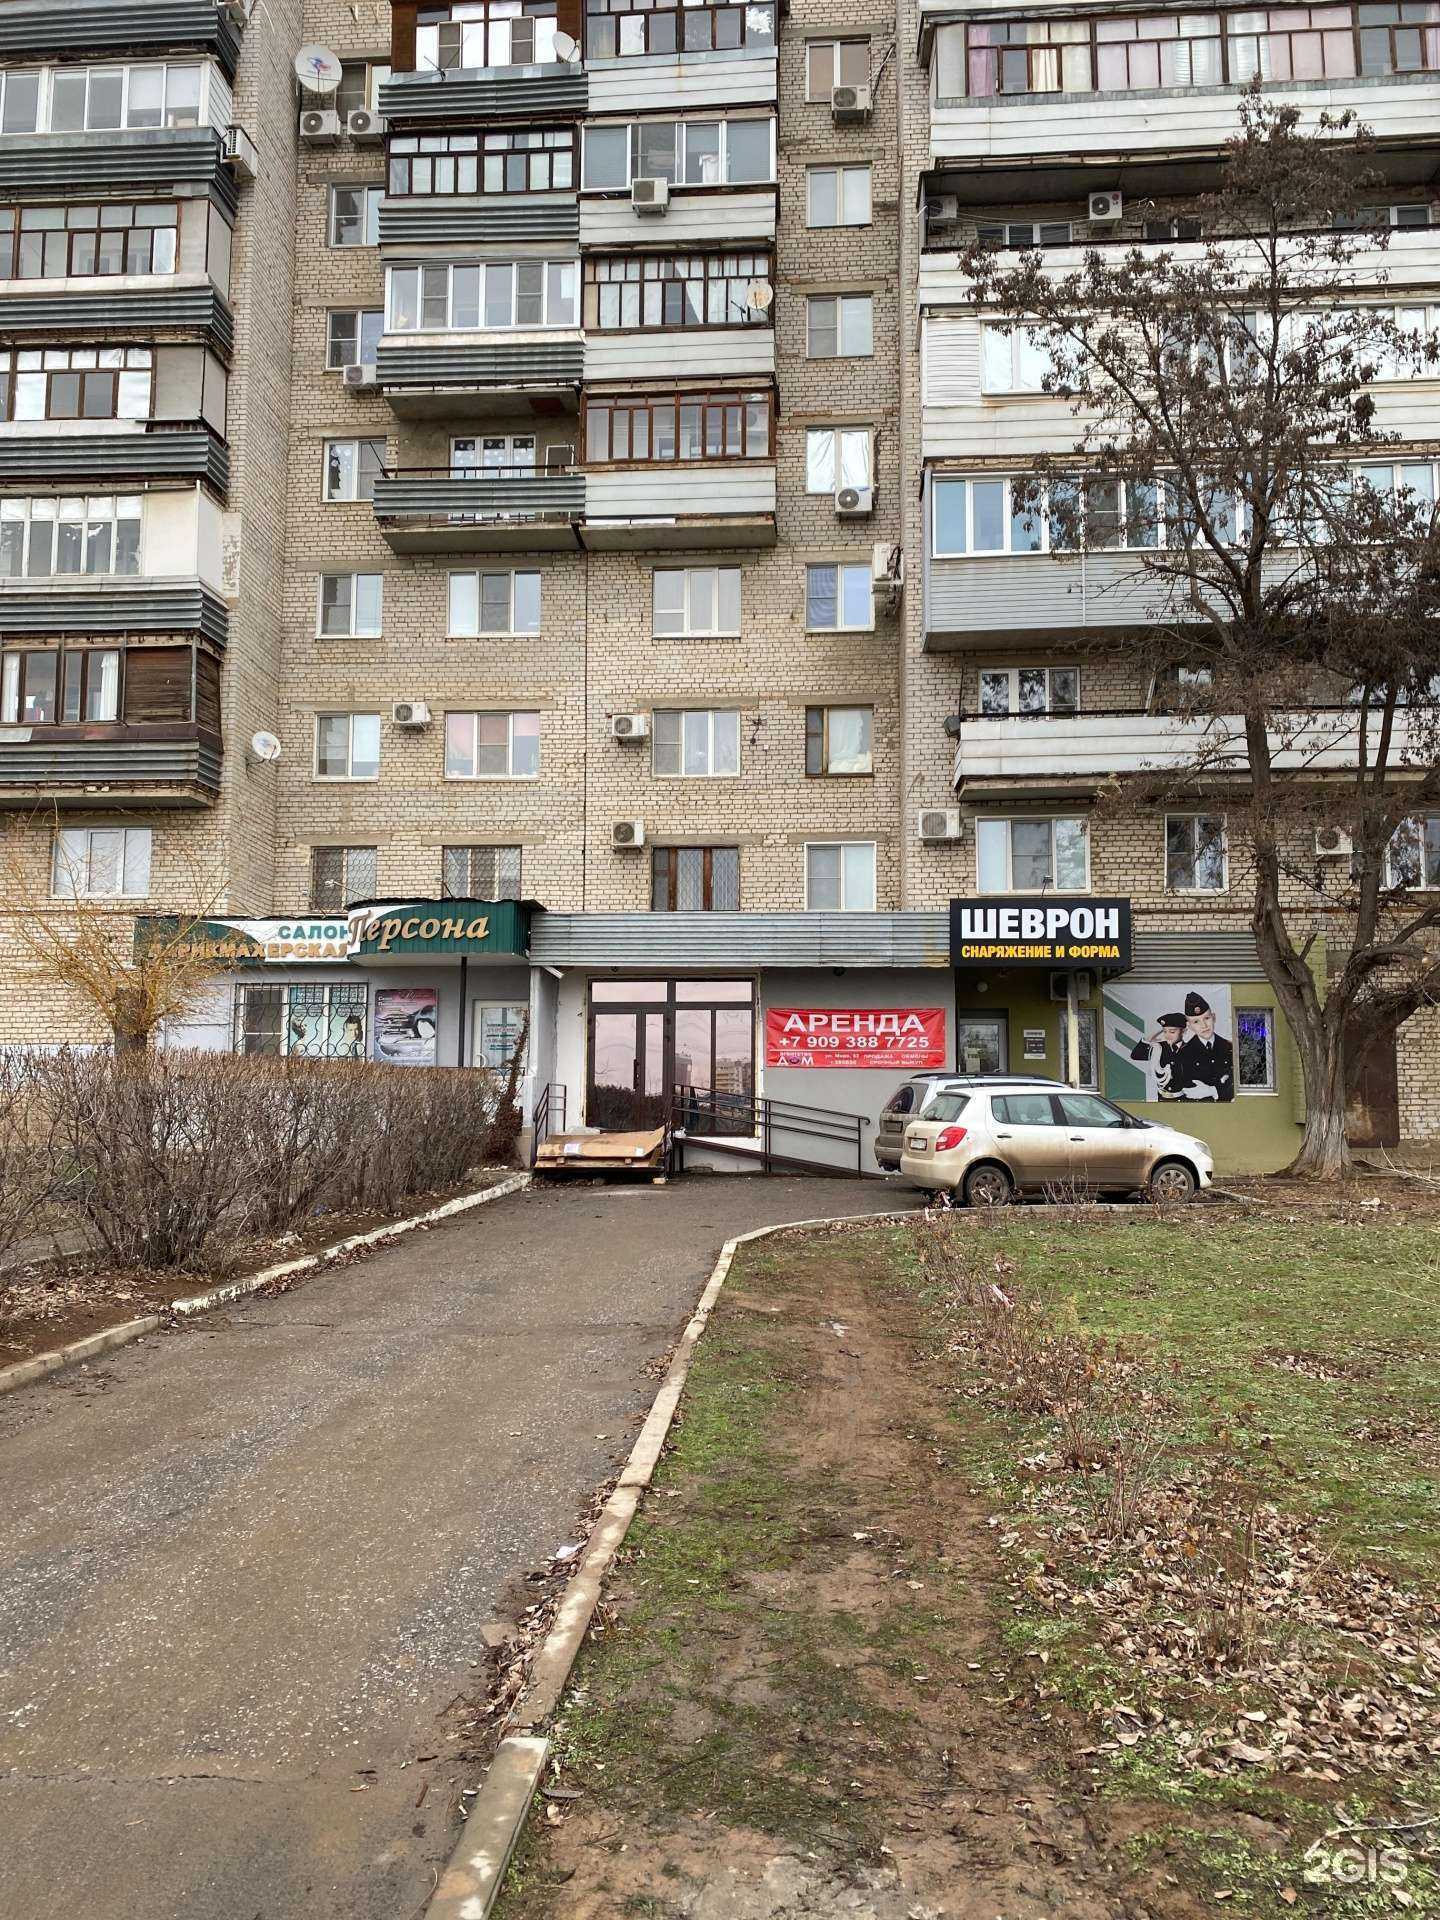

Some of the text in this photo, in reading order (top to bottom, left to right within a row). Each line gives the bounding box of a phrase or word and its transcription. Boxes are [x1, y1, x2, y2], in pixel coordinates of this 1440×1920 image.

[347, 909, 490, 950] Персона
[961, 908, 1119, 939] ШЕВРОН
[961, 945, 1120, 958] СНАРЯЖЕНИЕ И ФОРМА
[783, 1013, 925, 1036] АРЕНДА
[779, 1036, 929, 1048] +7 909 388 7725
